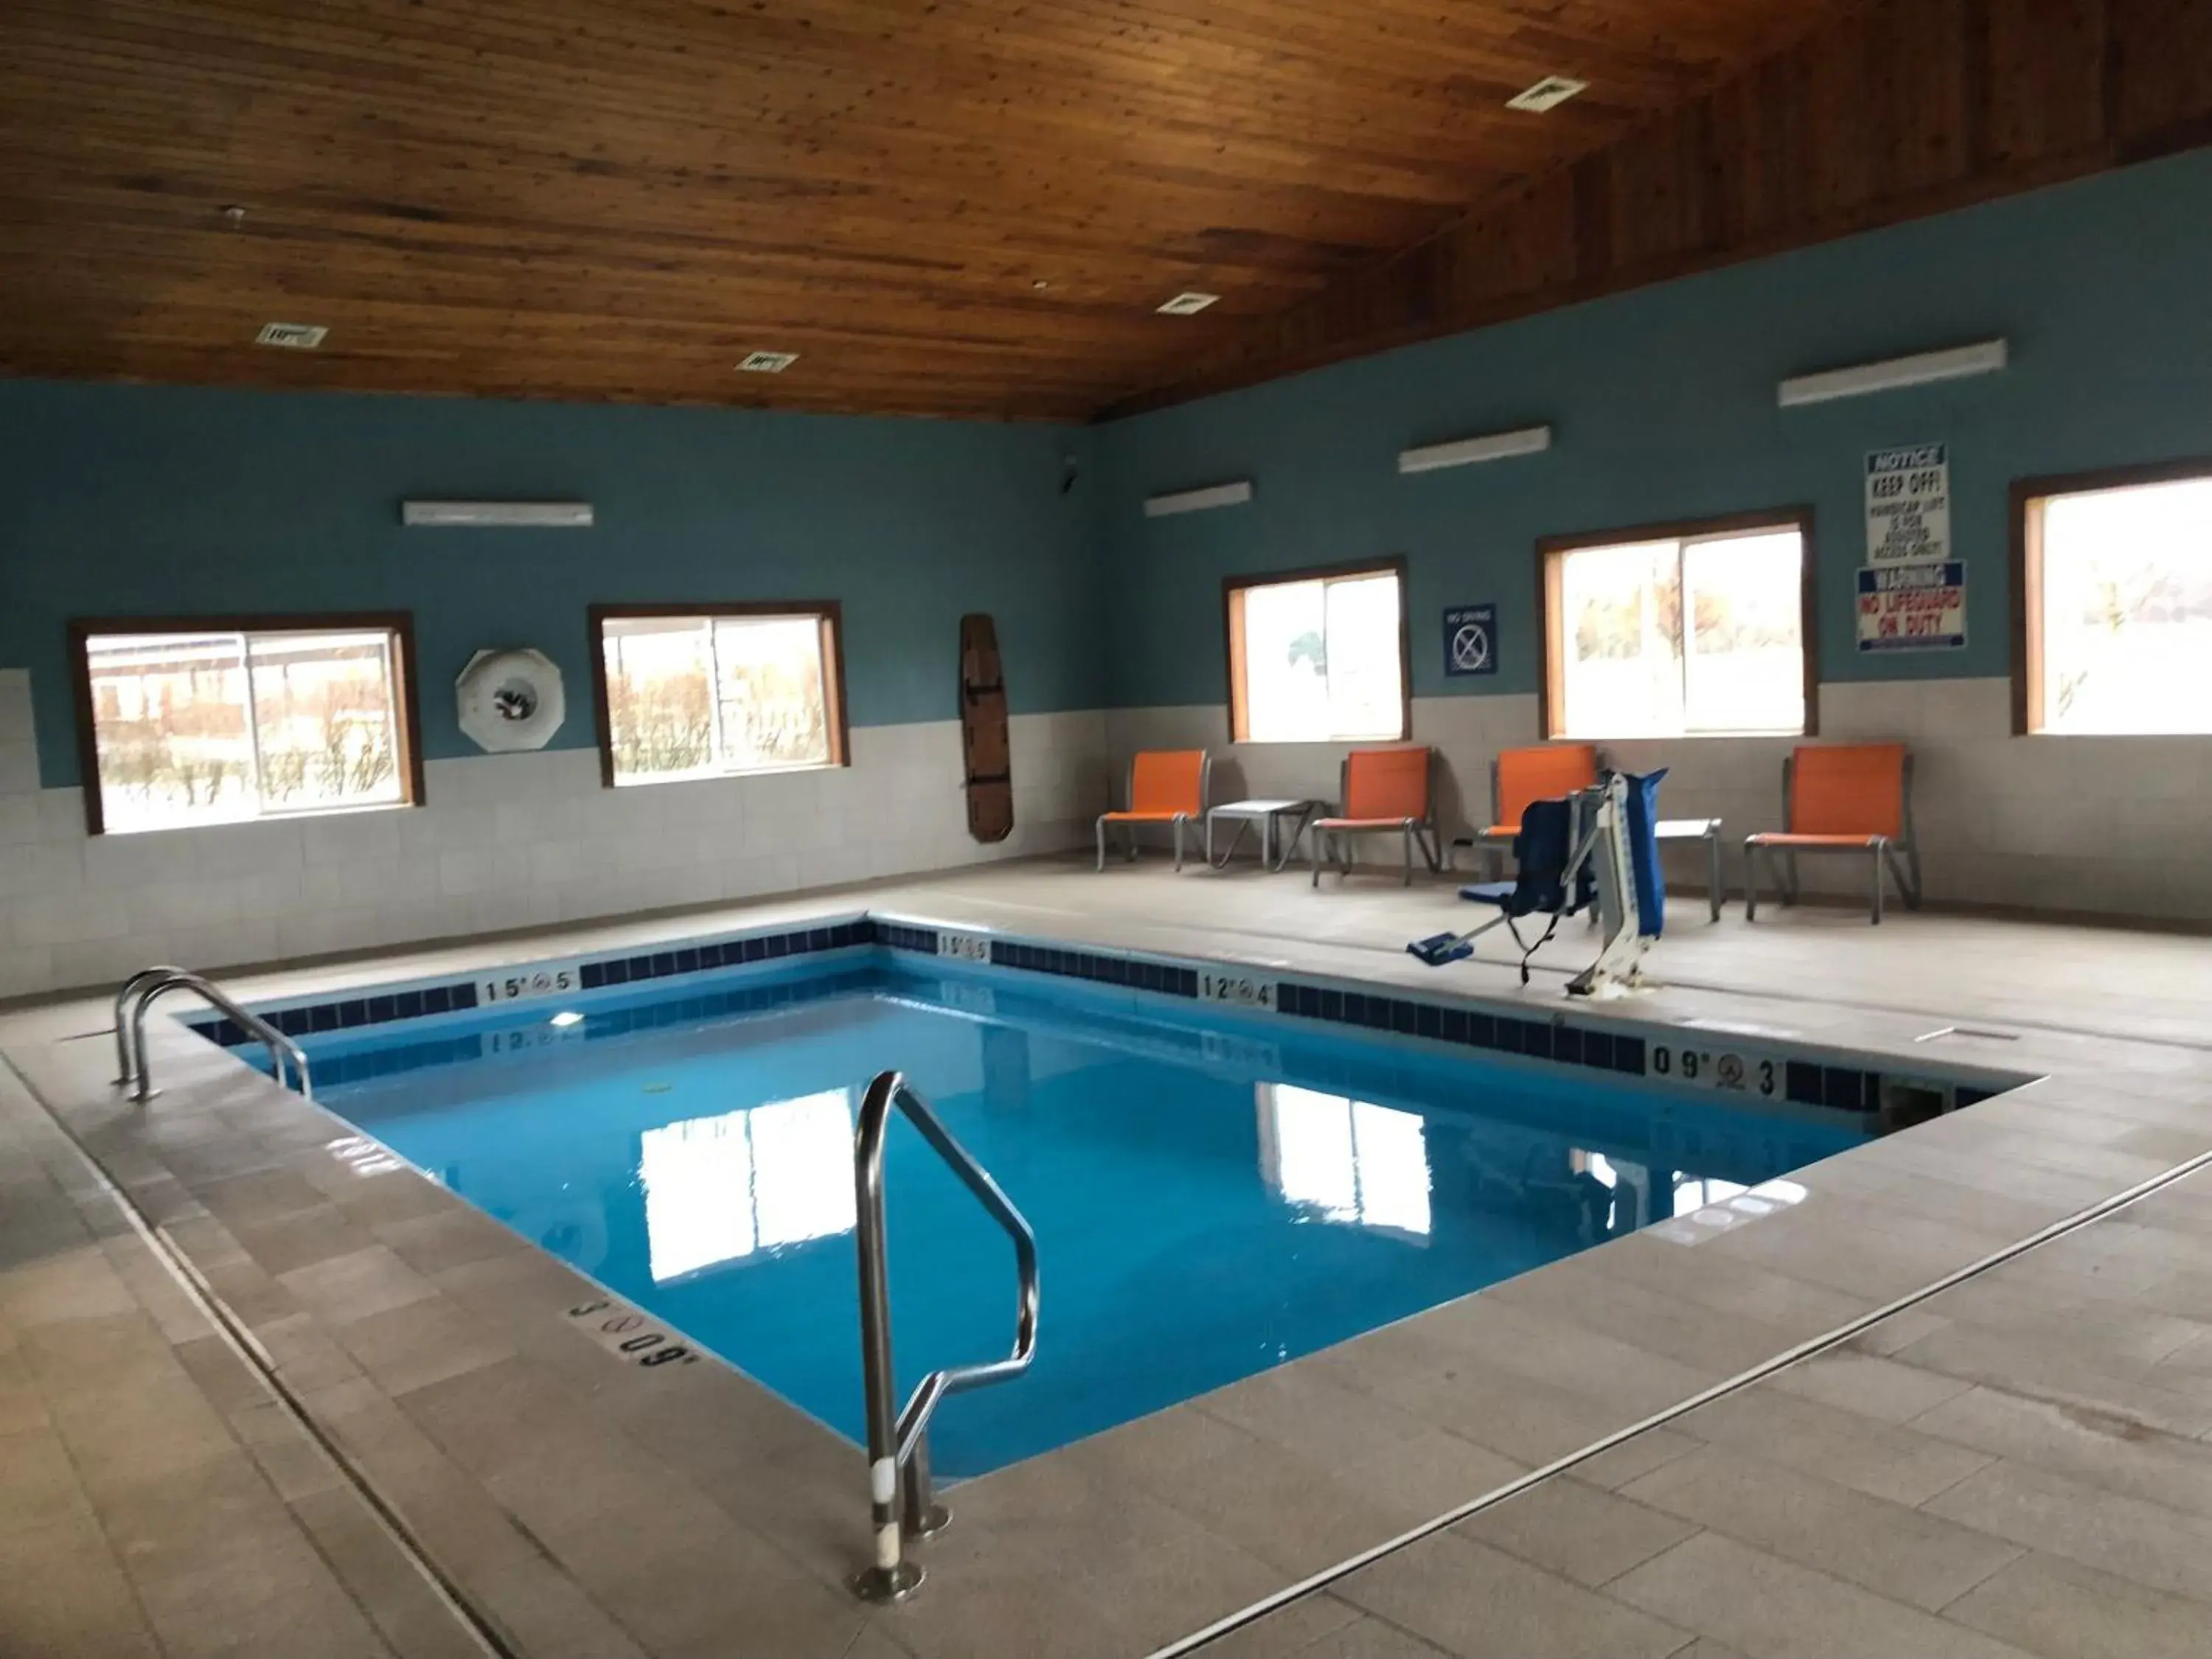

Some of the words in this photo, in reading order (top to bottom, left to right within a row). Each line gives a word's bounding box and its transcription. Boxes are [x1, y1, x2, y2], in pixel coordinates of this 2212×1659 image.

[1875, 448, 1939, 473] NOTICE
[1872, 476, 1904, 498] KEEP
[1860, 594, 1879, 613] NO
[1885, 588, 1961, 612] LIFEGUARD
[1905, 613, 1941, 635] DUTY
